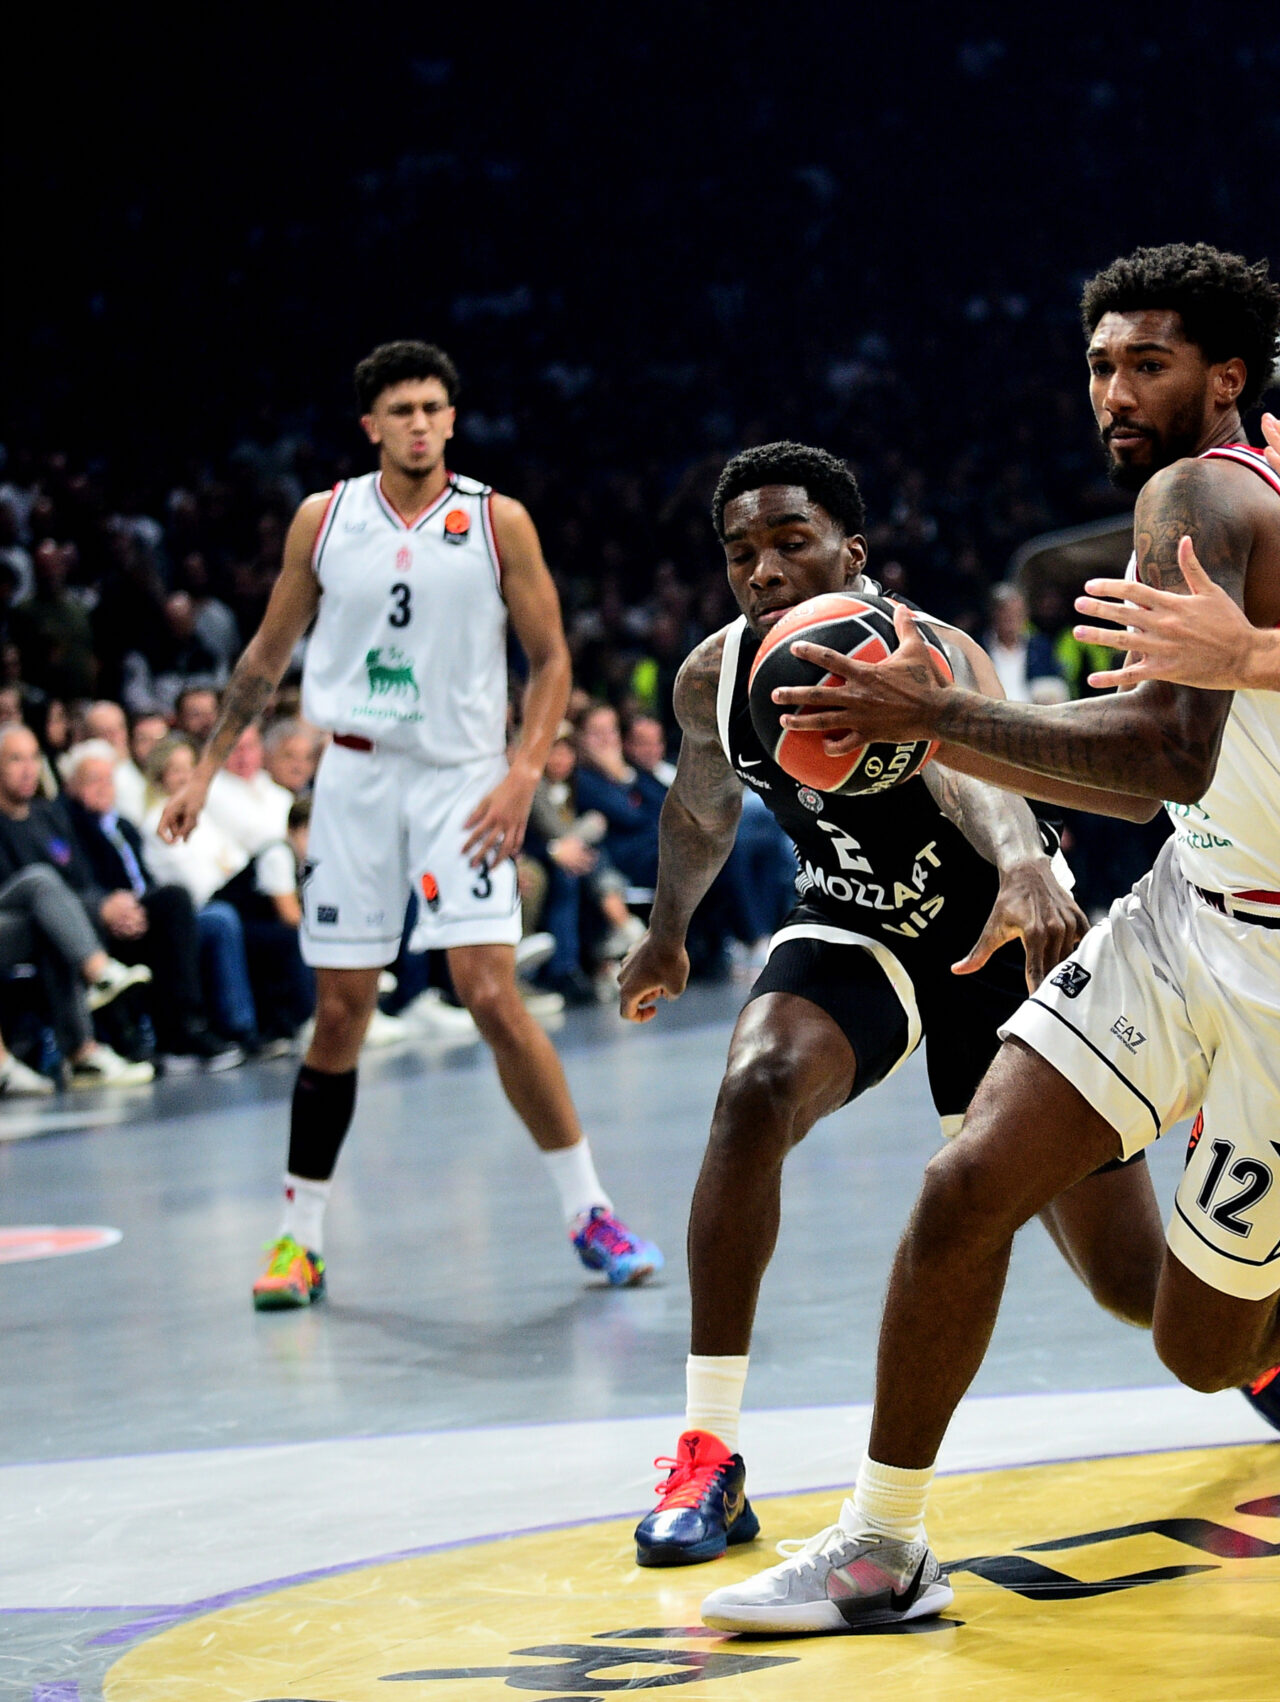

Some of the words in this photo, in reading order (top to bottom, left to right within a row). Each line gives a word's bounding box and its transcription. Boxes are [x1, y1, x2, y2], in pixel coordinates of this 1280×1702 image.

[388, 582, 411, 629] 3
[816, 819, 874, 875] 2
[472, 857, 493, 899] 3
[805, 840, 942, 911] MOZZART
[1113, 1015, 1147, 1047] EA7
[1196, 1138, 1273, 1239] 12
